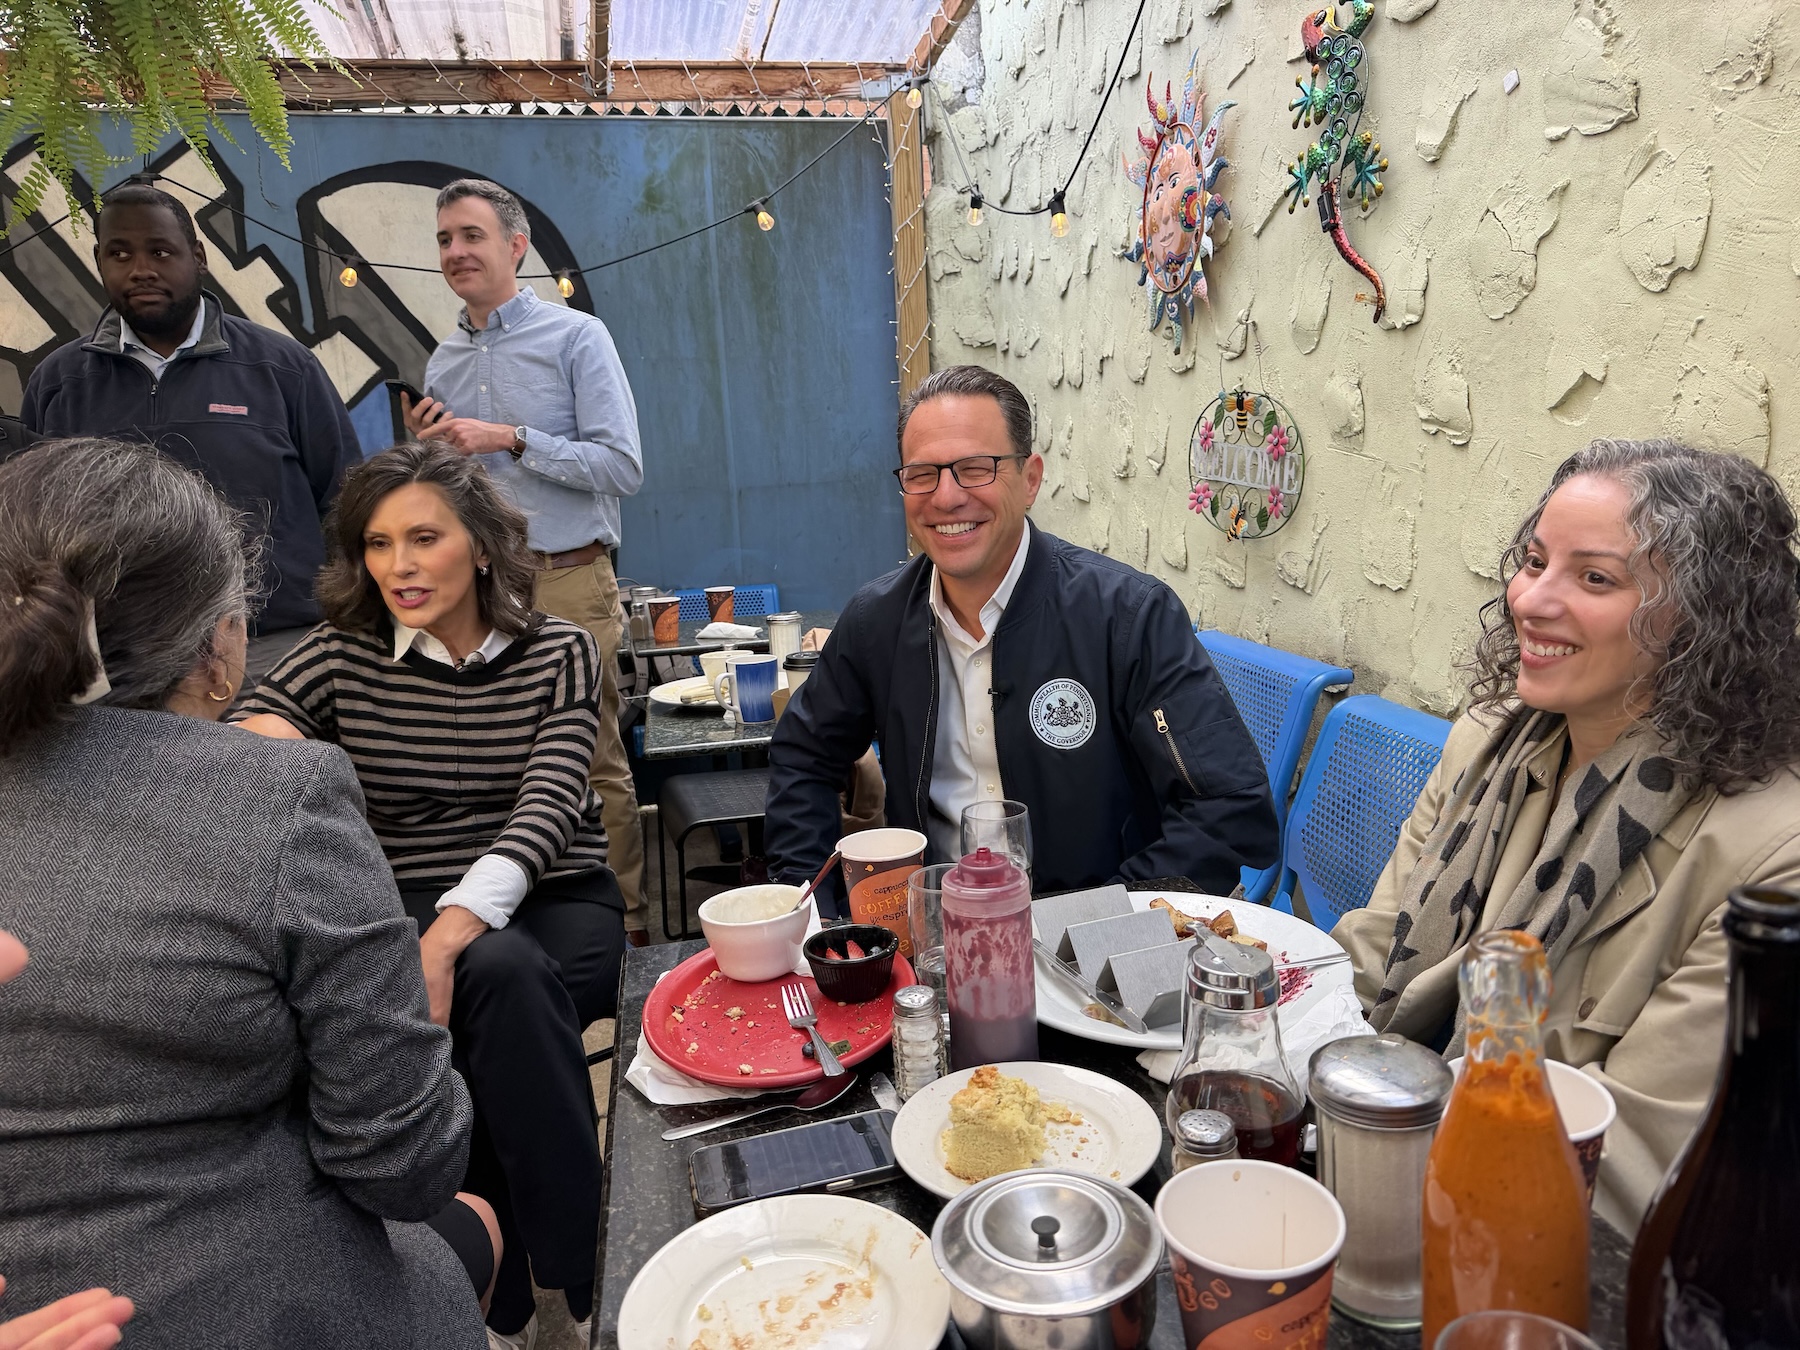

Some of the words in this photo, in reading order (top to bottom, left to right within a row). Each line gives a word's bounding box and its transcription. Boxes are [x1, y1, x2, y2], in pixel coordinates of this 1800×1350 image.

[1193, 439, 1299, 494] WELCOME
[1033, 684, 1060, 727] COMMONWEALTH
[1069, 684, 1092, 723] PENNSYLVANIA
[1044, 732, 1057, 743] THE
[1056, 730, 1087, 744] GOVERNOR
